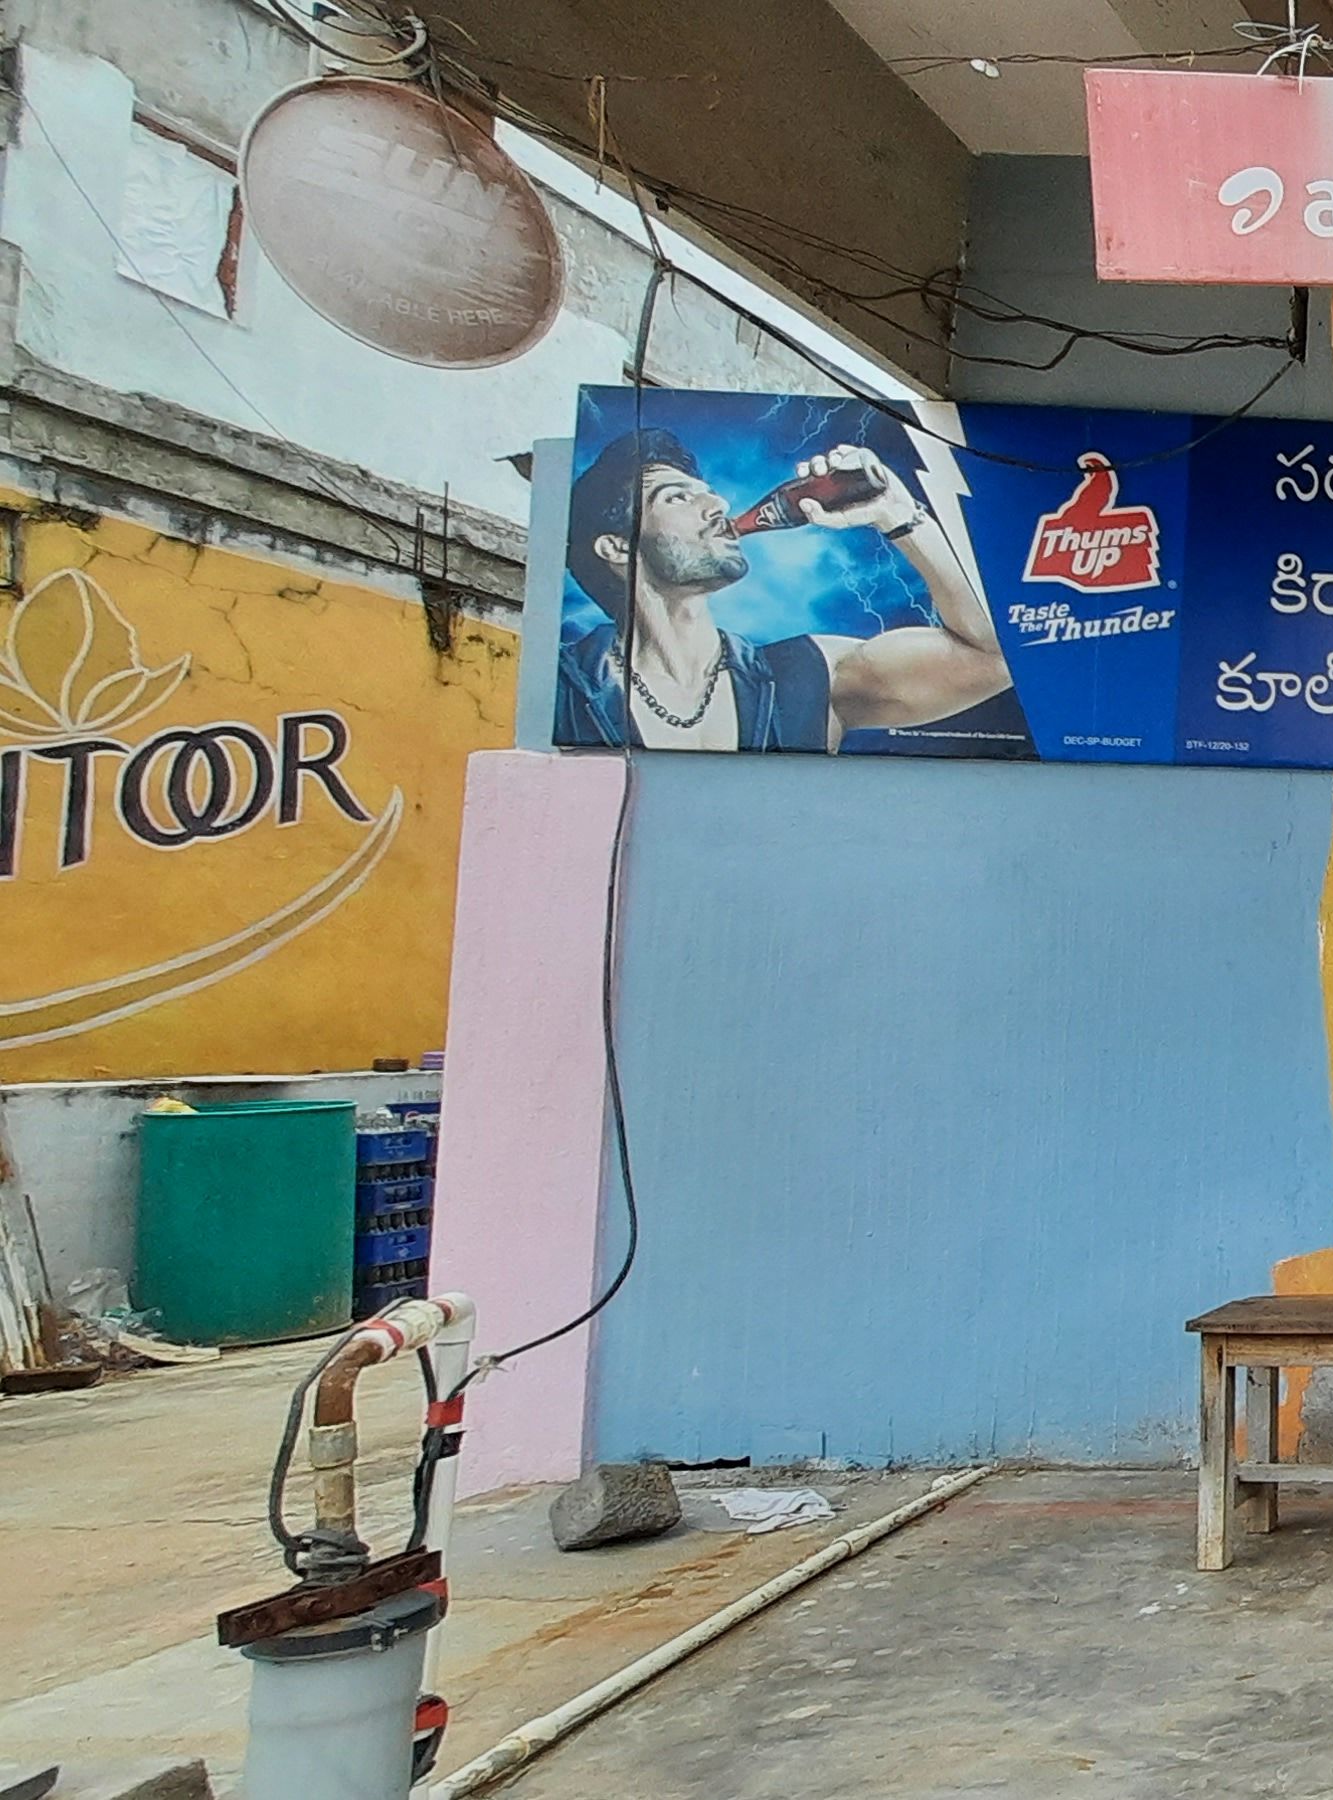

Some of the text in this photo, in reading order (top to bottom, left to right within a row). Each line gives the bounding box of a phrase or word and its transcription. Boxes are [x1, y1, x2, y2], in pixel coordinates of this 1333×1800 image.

[1042, 523, 1149, 559] Thums
[1008, 601, 1070, 625] Taste
[1020, 605, 1176, 645] The Thunder
[1064, 735, 1142, 748] DEC-SP-BUDGET
